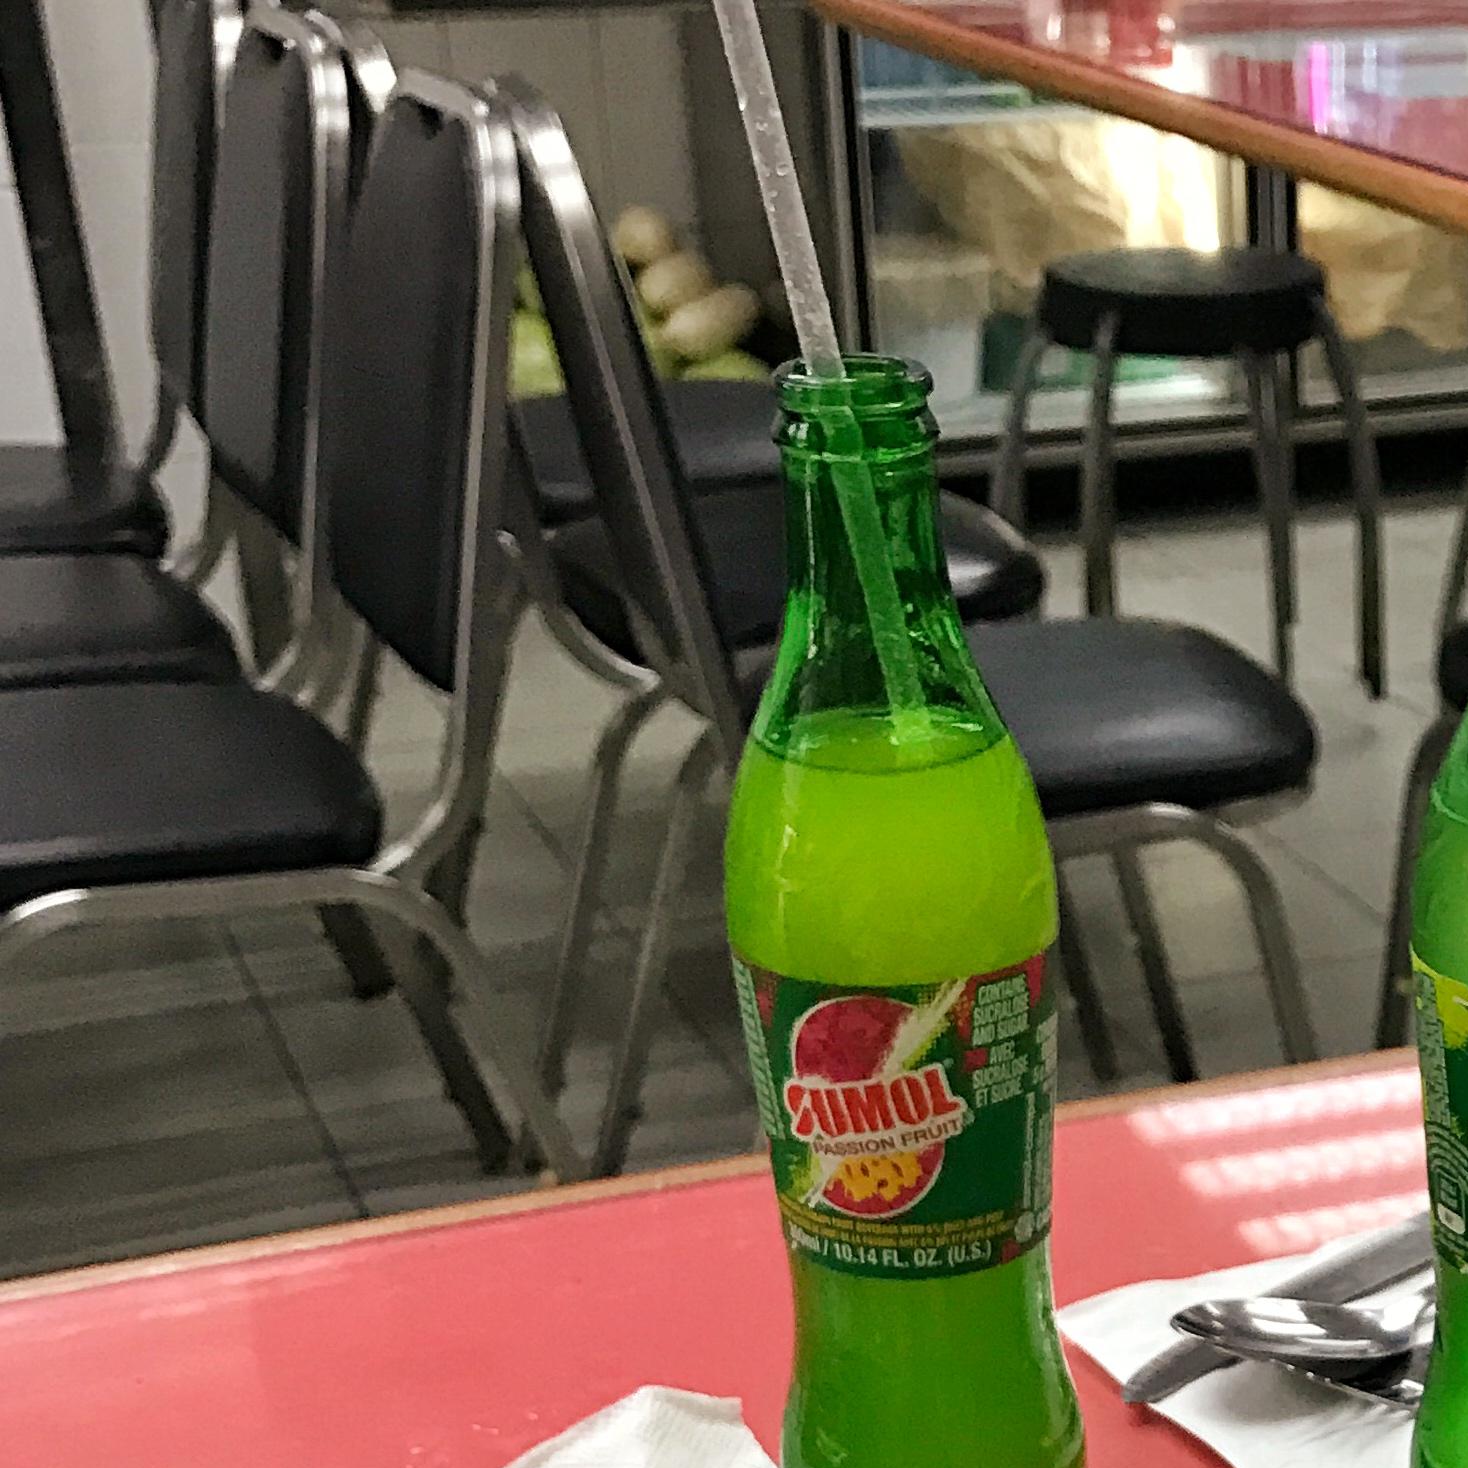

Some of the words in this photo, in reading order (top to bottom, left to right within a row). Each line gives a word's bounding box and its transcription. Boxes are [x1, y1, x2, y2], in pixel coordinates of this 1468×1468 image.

[785, 1066, 964, 1138] SUMOL
[813, 1135, 896, 1157] PASSION
[900, 1119, 961, 1147] FRUIT
[833, 1242, 878, 1266] 10.14
[882, 1248, 909, 1268] FL.
[914, 1247, 942, 1267] OZ.
